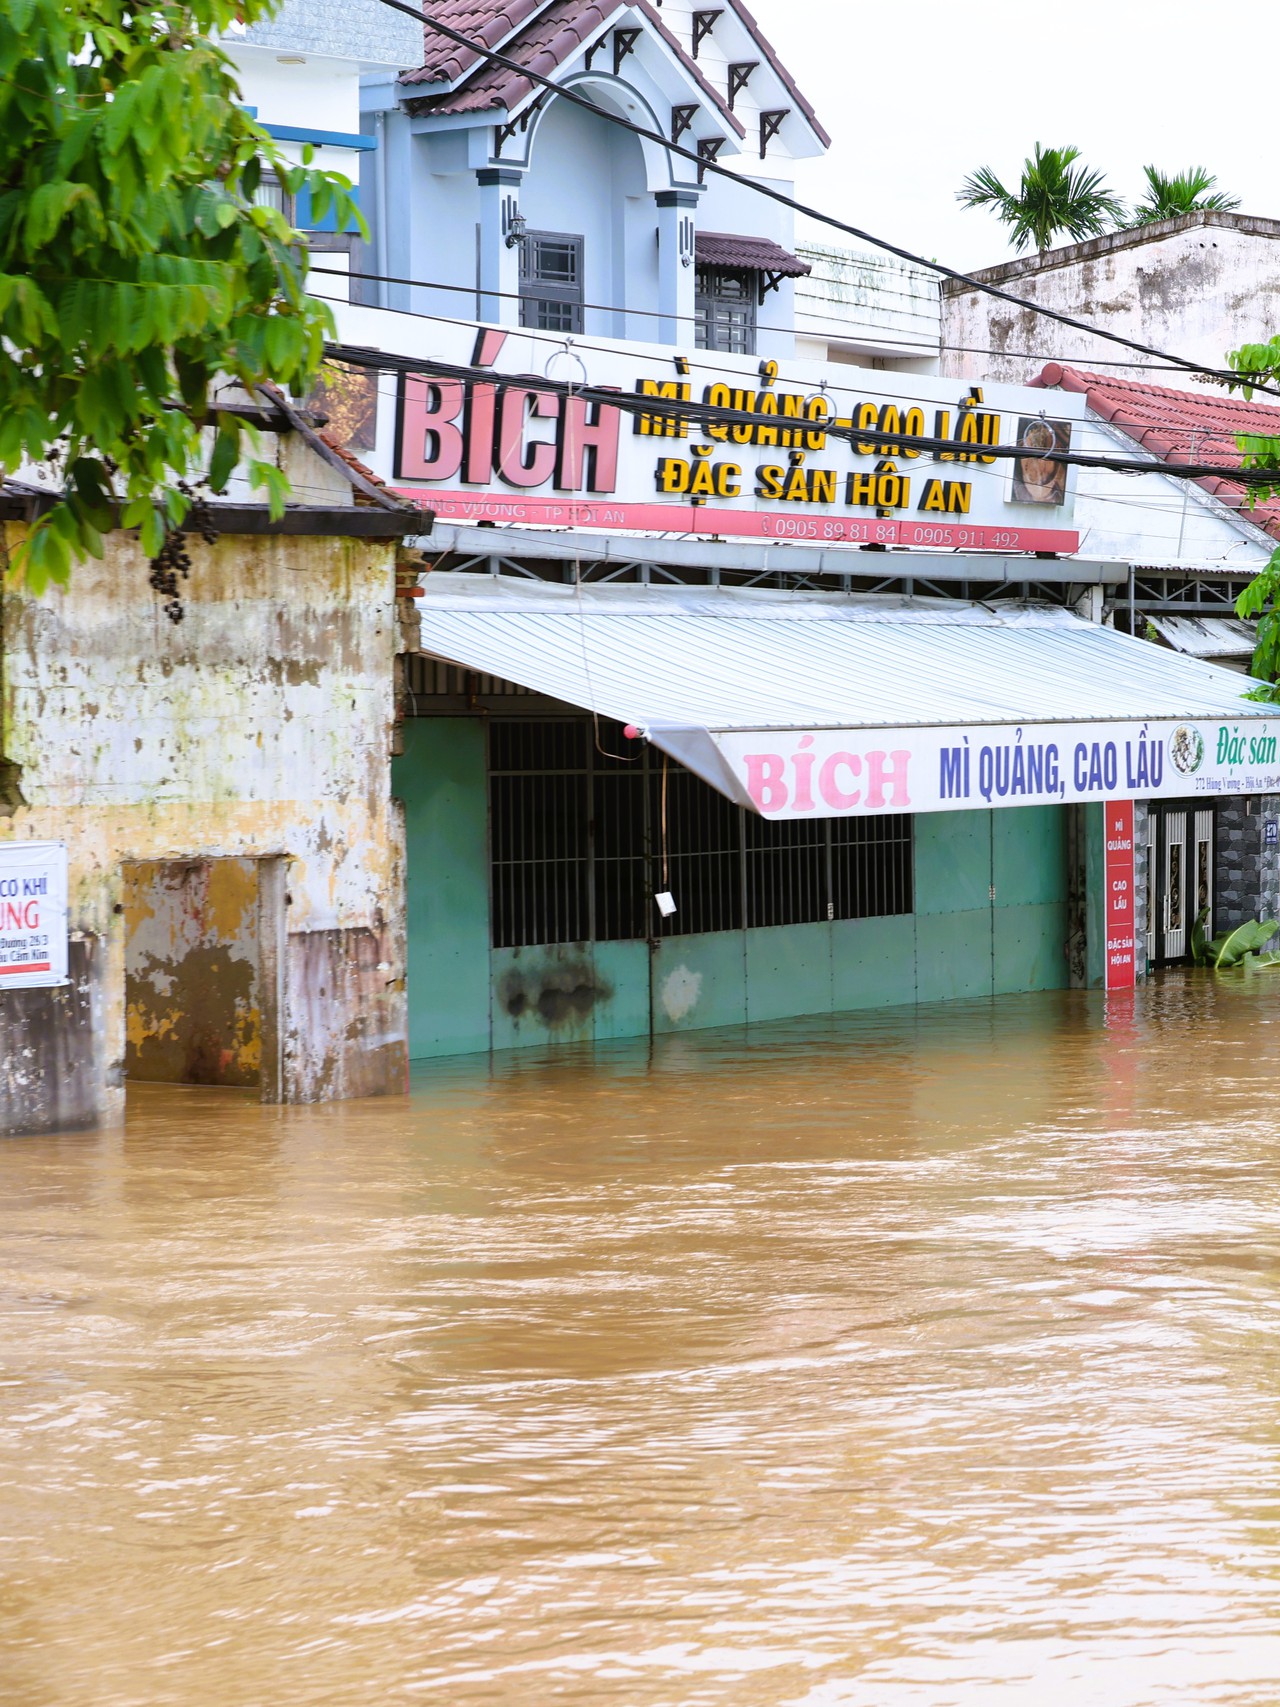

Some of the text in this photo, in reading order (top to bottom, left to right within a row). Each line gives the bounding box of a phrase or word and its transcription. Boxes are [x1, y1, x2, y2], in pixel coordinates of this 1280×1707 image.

[394, 328, 622, 493] BÍCH
[634, 356, 691, 438] MÌ
[702, 360, 828, 450] QUẢNG
[853, 402, 925, 459] CAO
[933, 386, 1000, 464] LẦU
[655, 444, 972, 517] ĐẶC SẢN HỘI AN
[545, 507, 563, 520] TP
[603, 509, 625, 524] AN
[775, 519, 817, 537] 0905
[823, 521, 844, 538] 89
[850, 524, 868, 540] 81
[876, 525, 896, 541] 84
[914, 527, 952, 544] 0905
[958, 530, 985, 546] 911
[991, 532, 1019, 548] 492
[743, 723, 1163, 812] BÍCH MÌ QUẢNG, CAO LẦU
[1216, 725, 1246, 776] Đặc
[1250, 724, 1277, 766] sản
[1107, 836, 1131, 851] QUẢNG
[1112, 880, 1127, 891] CAO
